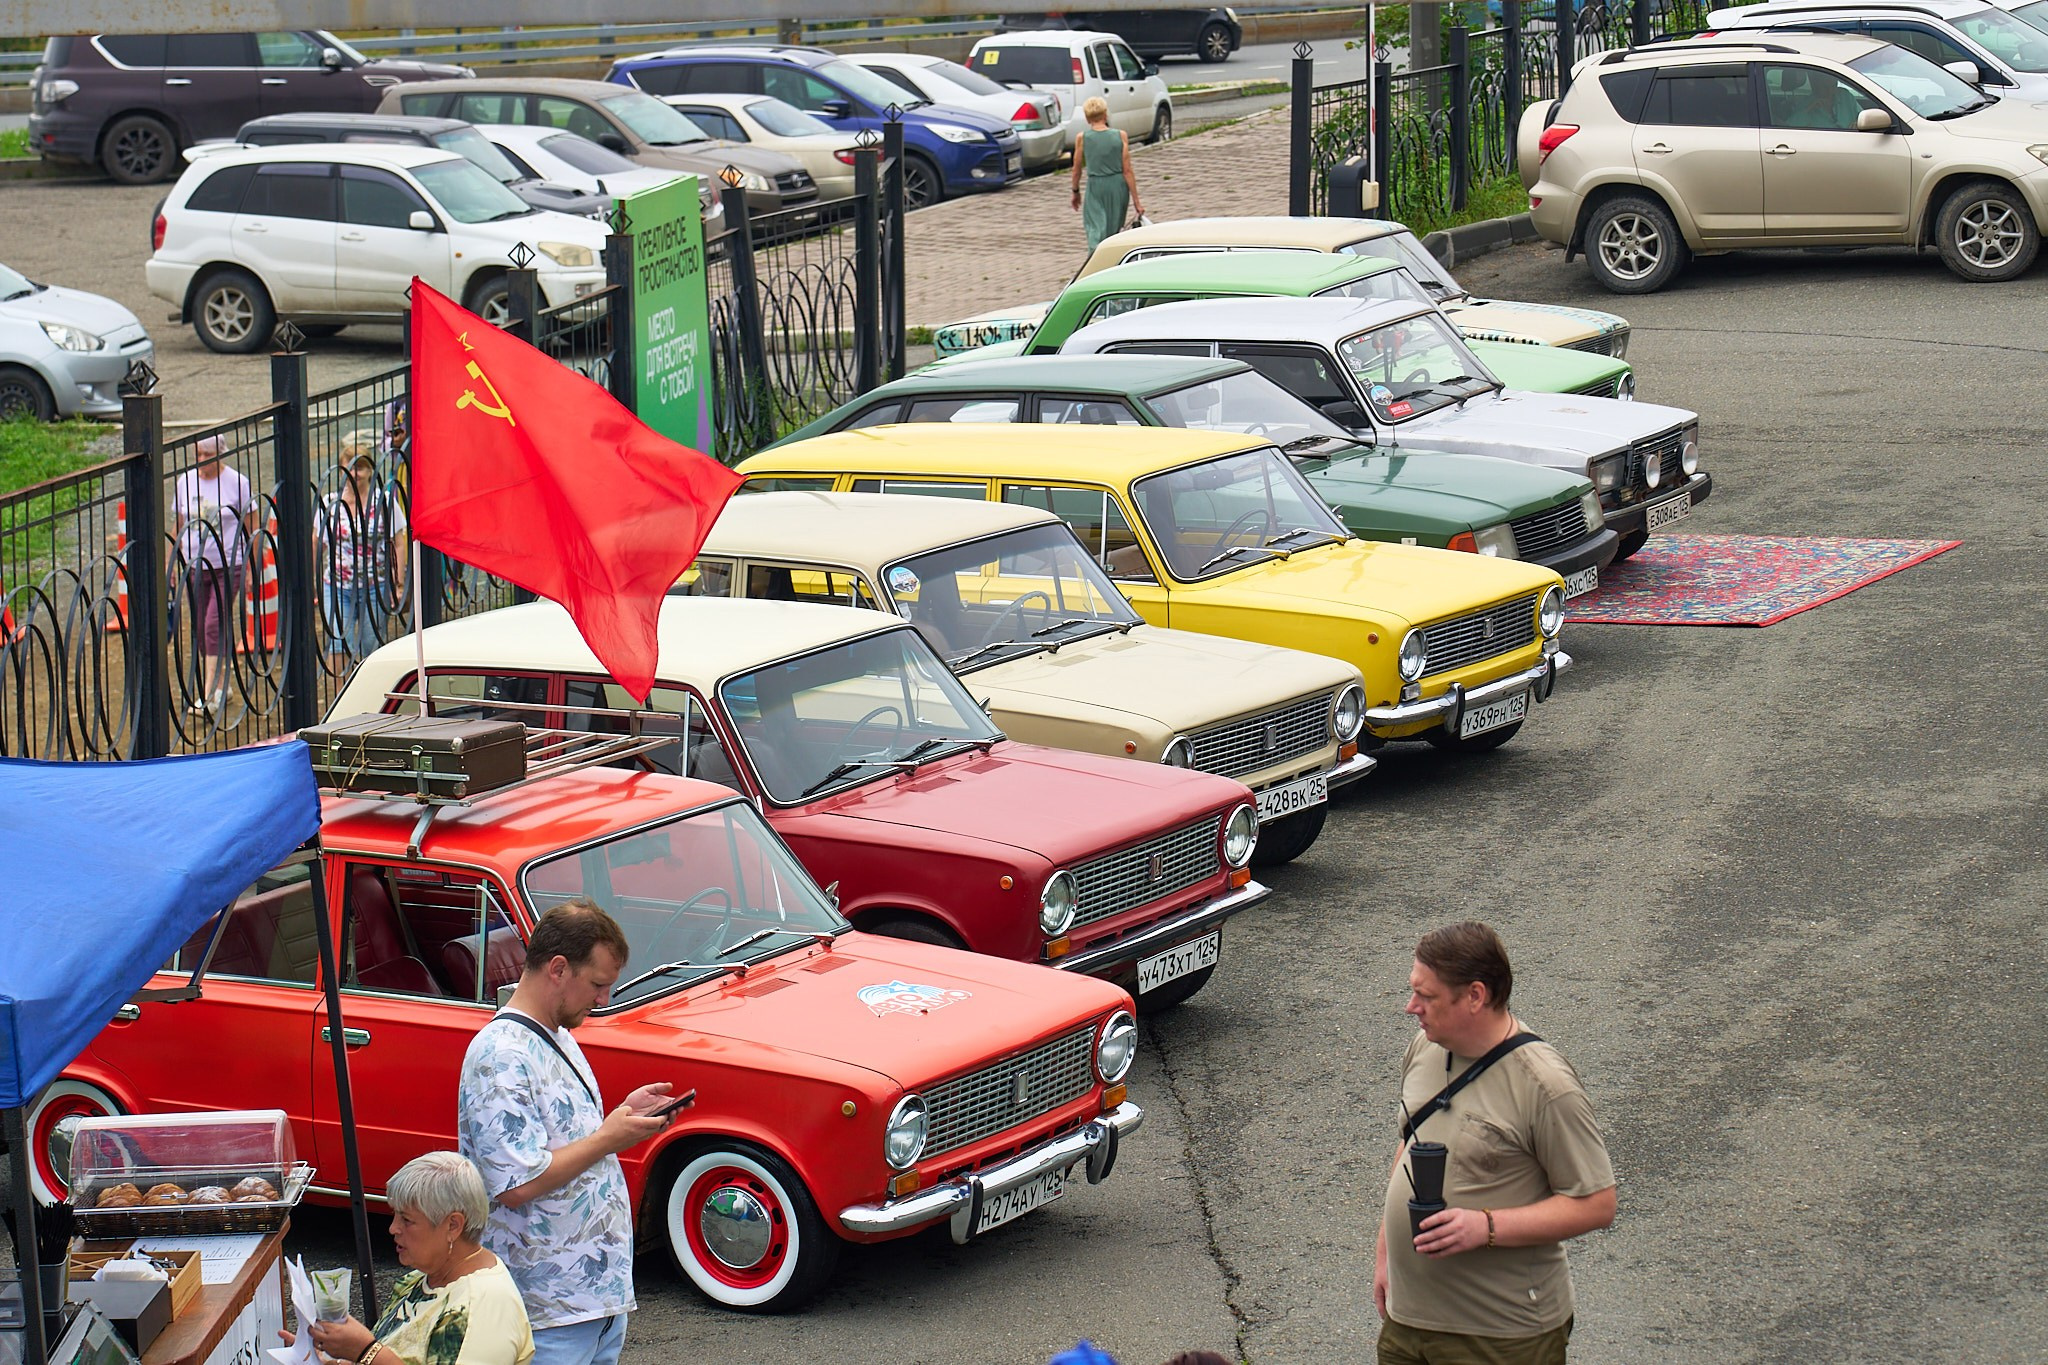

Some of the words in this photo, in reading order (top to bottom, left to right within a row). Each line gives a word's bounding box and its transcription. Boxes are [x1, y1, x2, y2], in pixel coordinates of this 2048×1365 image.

[637, 216, 687, 261] КРЕАТИВНОЕ
[639, 244, 699, 296] ПРОСТРАНСТВО
[648, 306, 676, 344] МЕСТО
[646, 343, 664, 385] ДЛЯ
[663, 329, 698, 375] ВСТРЕЧИ
[660, 380, 667, 405] С
[667, 362, 695, 402] ТОБОЙ
[1584, 568, 1597, 584] 125
[1465, 706, 1507, 733] У369РН
[1508, 695, 1524, 713] 125
[1309, 777, 1323, 797] 25
[1143, 951, 1193, 989] У473ХТ
[1196, 936, 1217, 960] 125
[1201, 957, 1212, 965] RUS
[981, 1184, 1038, 1228] Н274АУ
[1040, 1168, 1061, 1193] 125
